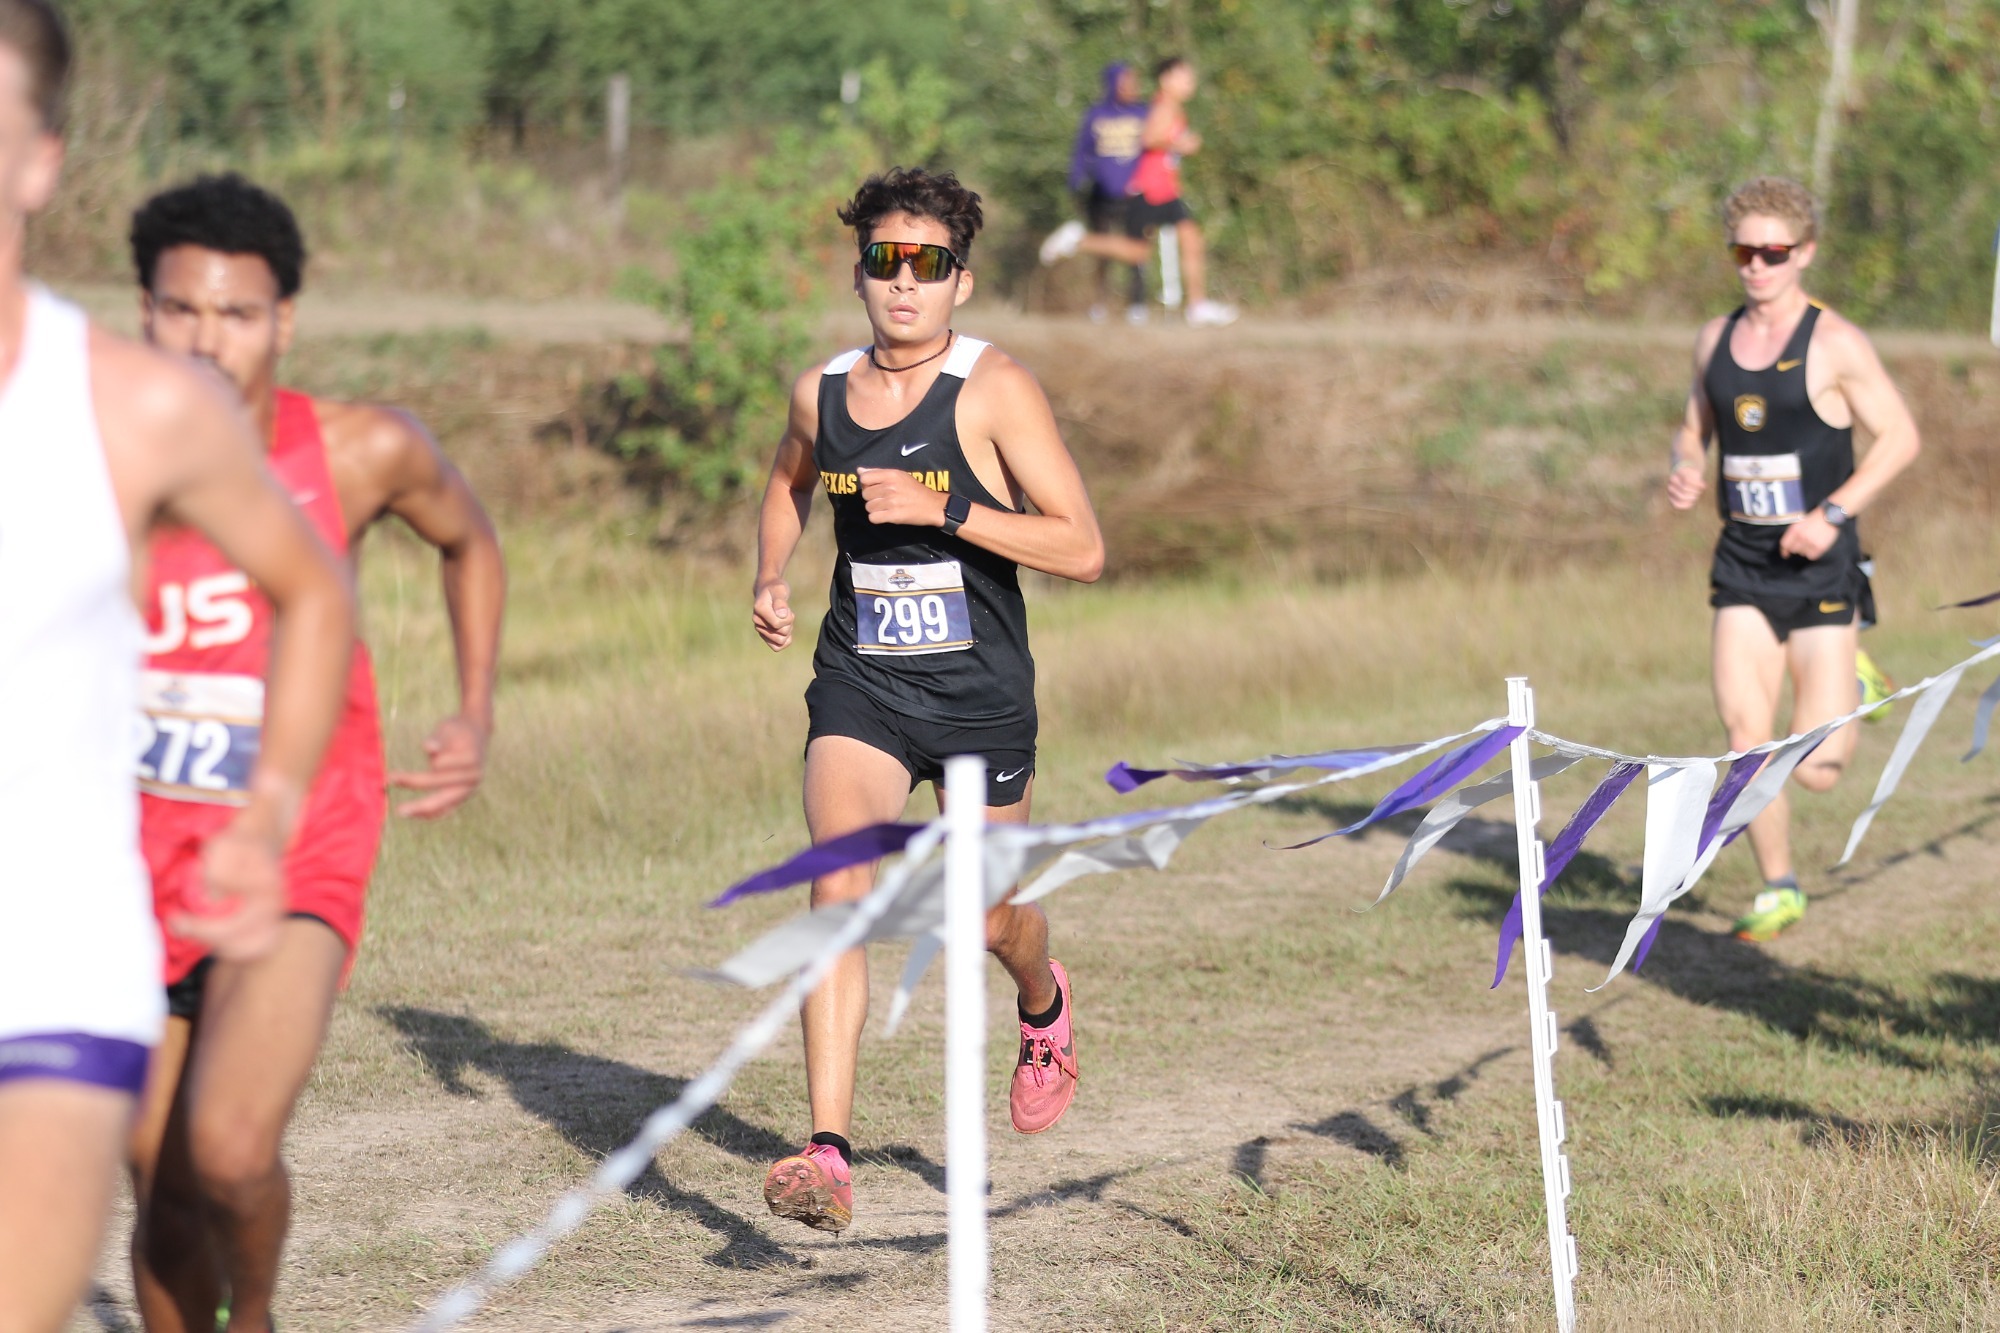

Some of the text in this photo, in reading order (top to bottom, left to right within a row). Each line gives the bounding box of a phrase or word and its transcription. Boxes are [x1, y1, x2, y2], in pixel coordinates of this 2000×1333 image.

[820, 471, 857, 494] TEXAS
[1735, 480, 1787, 516] 131
[874, 595, 949, 645] 299
